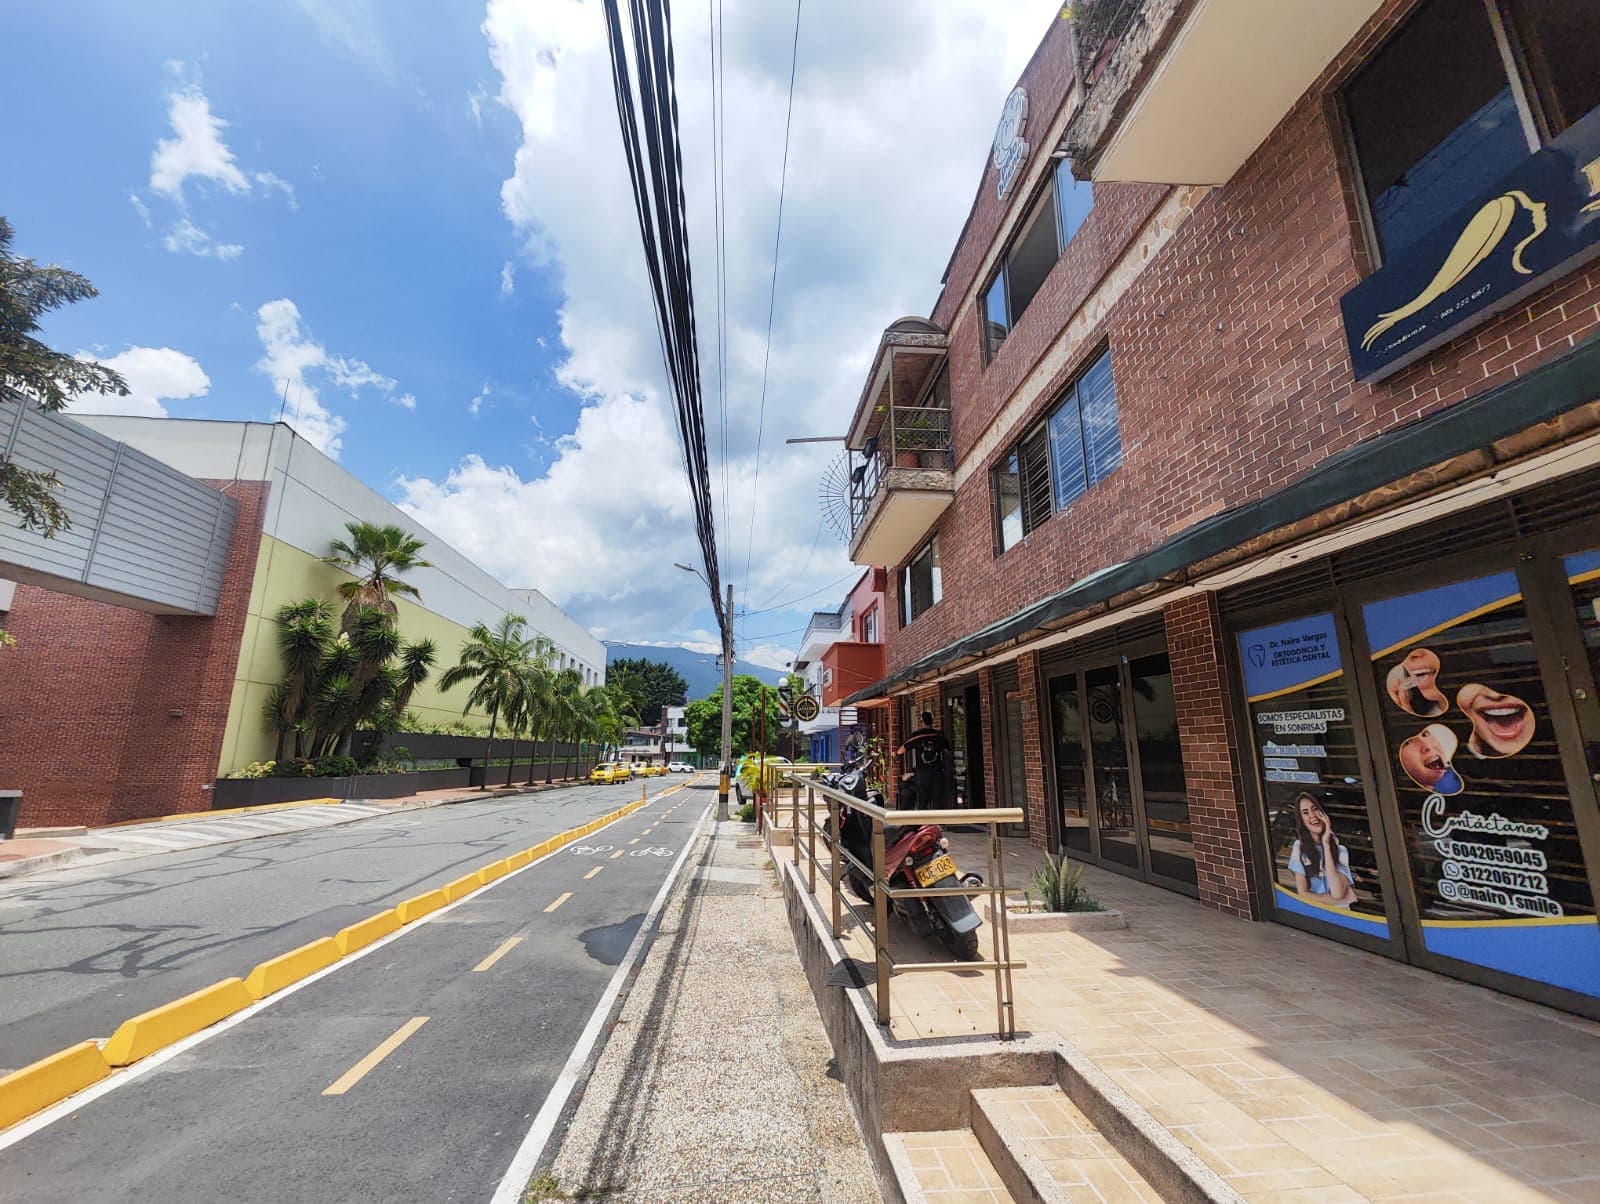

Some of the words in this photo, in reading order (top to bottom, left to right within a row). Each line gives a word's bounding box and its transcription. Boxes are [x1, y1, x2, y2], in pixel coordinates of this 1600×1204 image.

[1455, 297, 1470, 310] 222
[1269, 640, 1280, 649] Dr.
[1281, 636, 1301, 647] Nairo
[1301, 631, 1329, 643] Vargas
[1273, 645, 1319, 659] ORTODONCIA
[1319, 643, 1327, 652] Y
[1302, 650, 1332, 662] DENTAL
[1258, 713, 1284, 723] SOMOS
[1284, 709, 1342, 721] ESPECIALISTAS
[1275, 724, 1287, 733] EN
[1287, 722, 1326, 732] SONRISAS
[1423, 795, 1545, 837] Contáctanos
[1451, 843, 1543, 868] 6042059045
[1461, 865, 1544, 891] 3122067212
